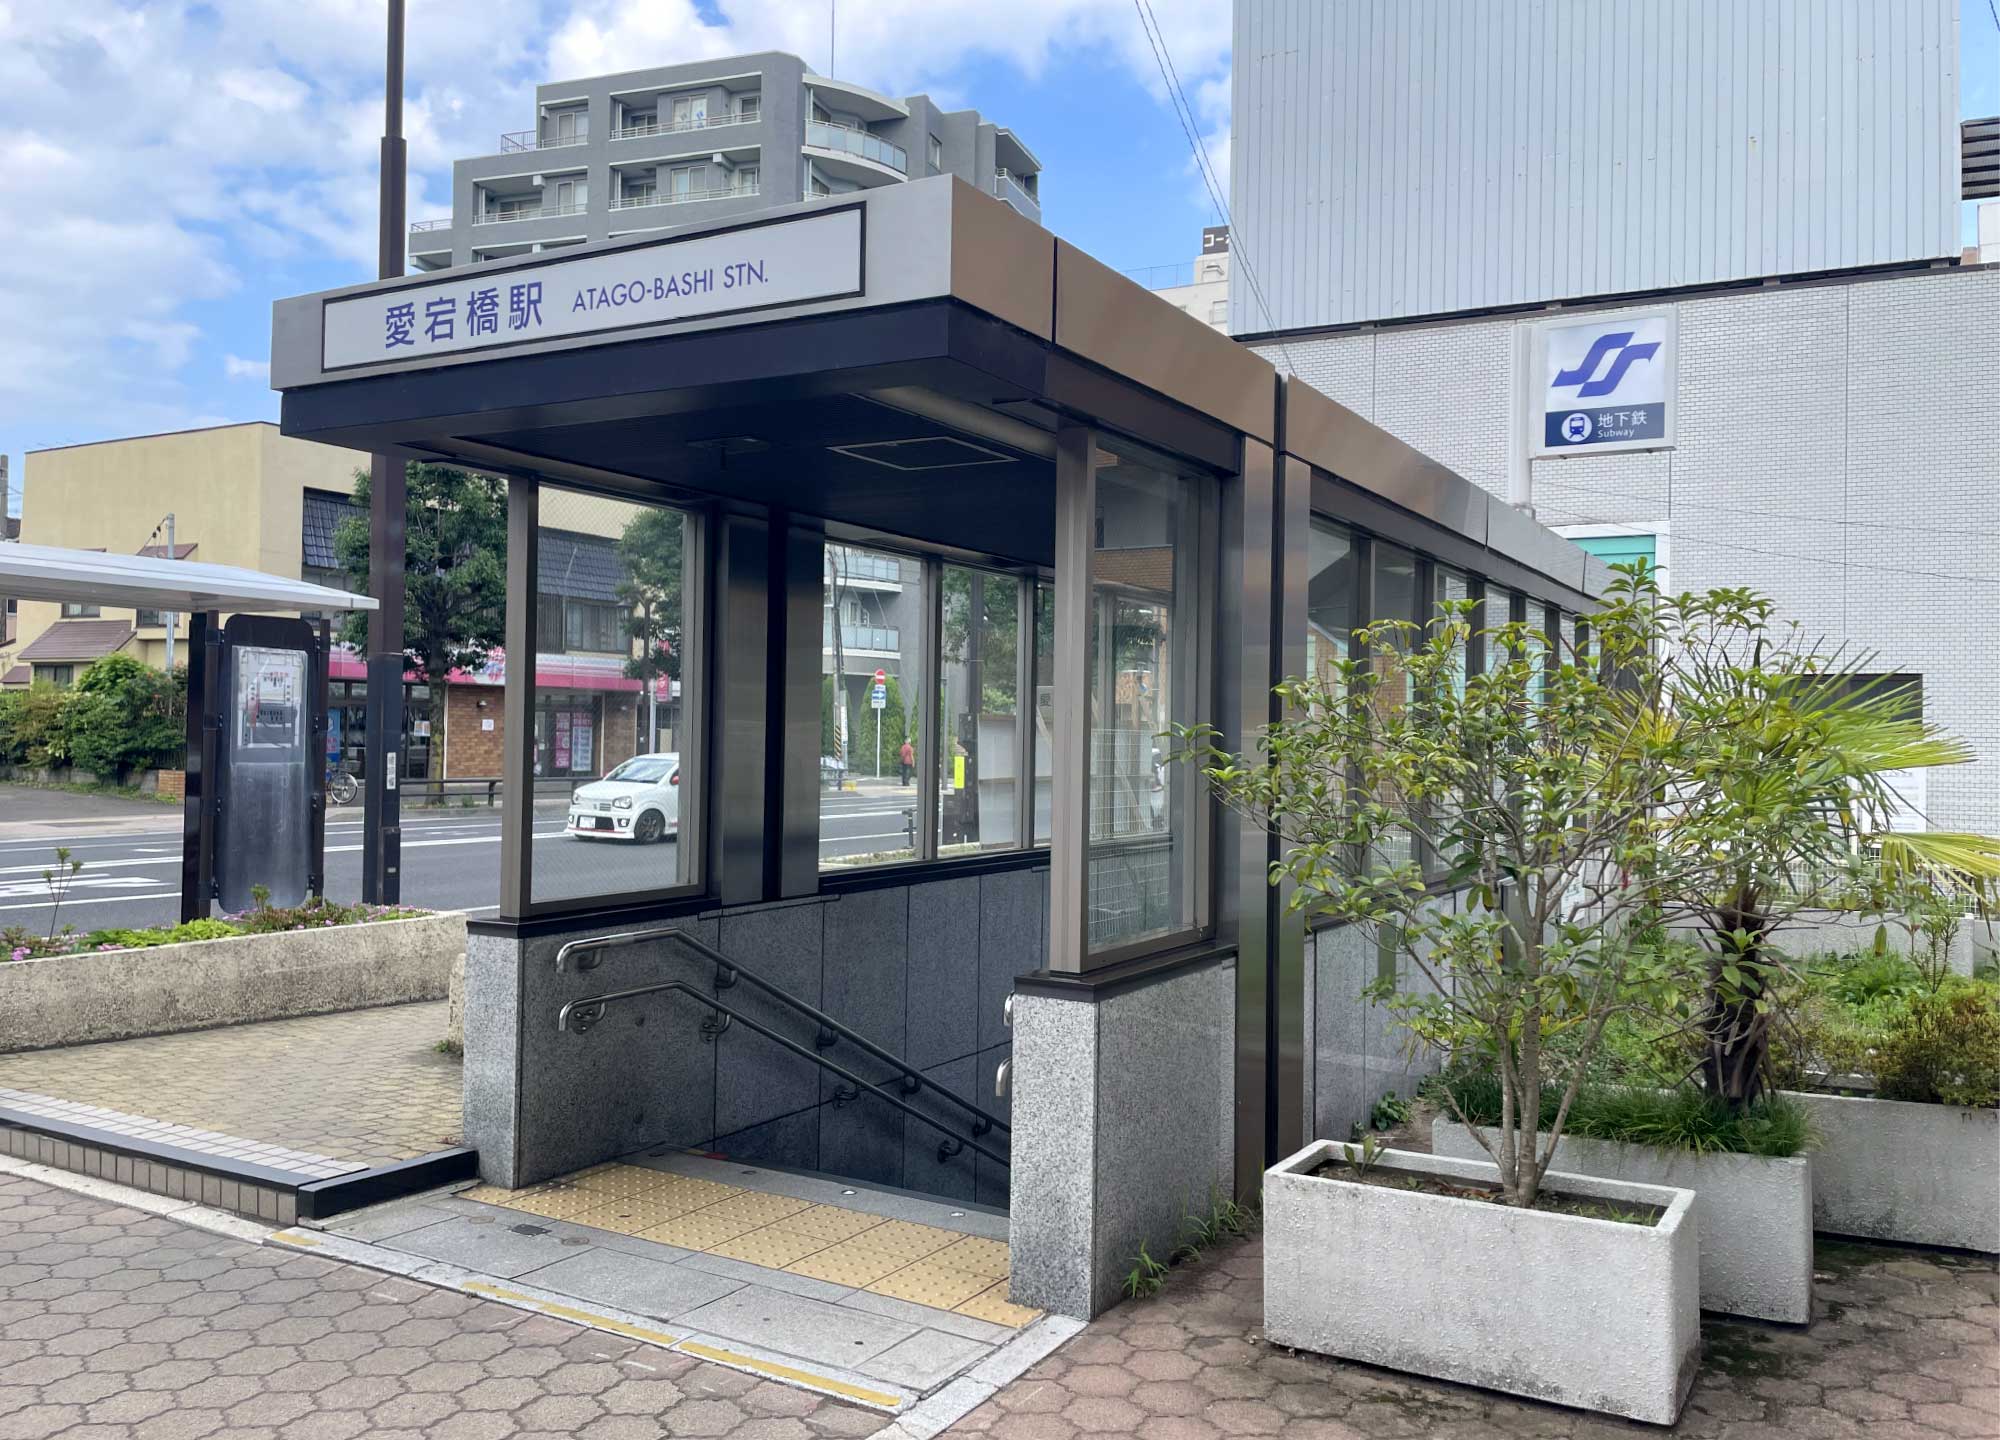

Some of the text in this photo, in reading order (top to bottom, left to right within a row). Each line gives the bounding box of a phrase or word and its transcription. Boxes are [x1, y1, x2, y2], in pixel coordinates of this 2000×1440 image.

[572, 259, 769, 313] ATAGO-BASHI STN.
[385, 281, 543, 349] 愛宕橋駅
[1597, 410, 1647, 427] 地下鉄
[1597, 428, 1634, 438] Subway
